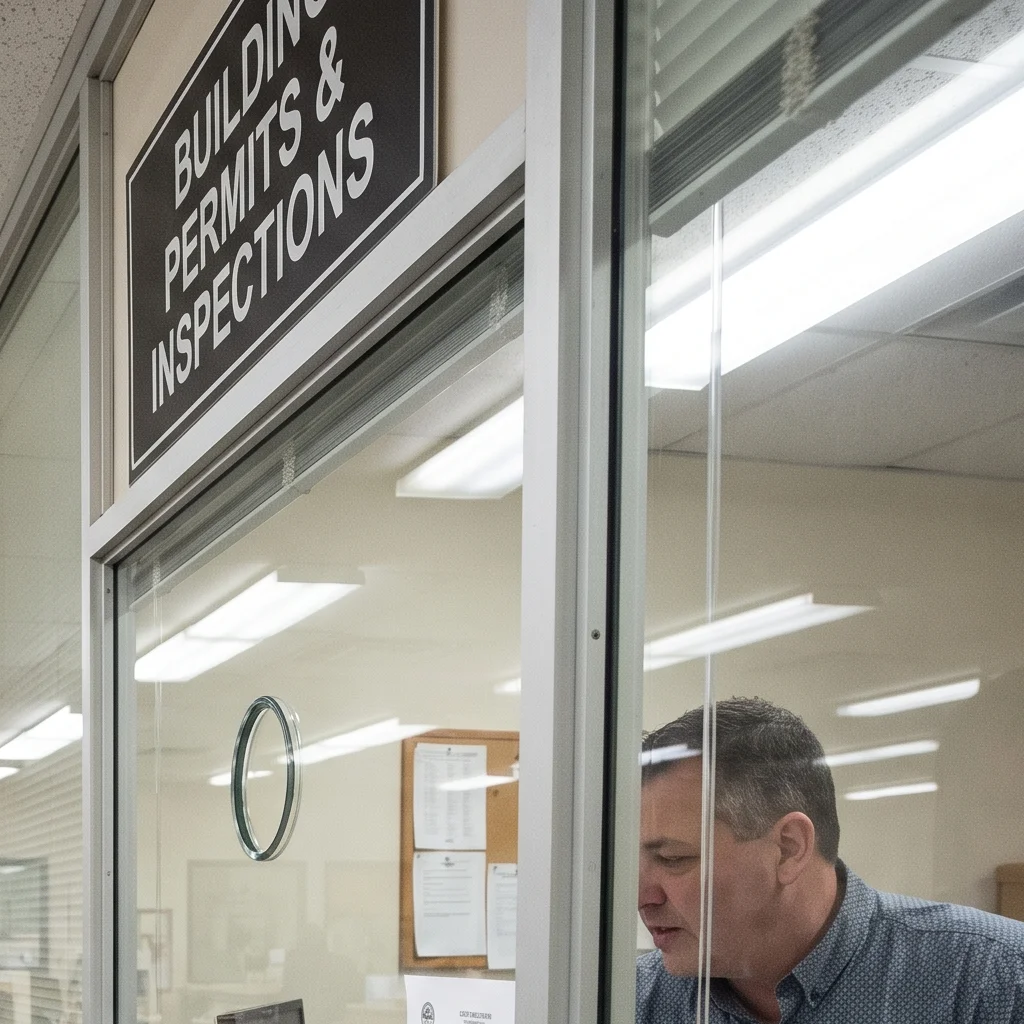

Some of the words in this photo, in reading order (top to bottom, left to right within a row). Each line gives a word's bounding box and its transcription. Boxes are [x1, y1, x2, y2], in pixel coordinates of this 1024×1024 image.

[165, 77, 302, 313] PERMITS
[316, 26, 345, 122] &
[175, 0, 326, 210] BUILDIN
[151, 102, 374, 413] INSPECTIONS
